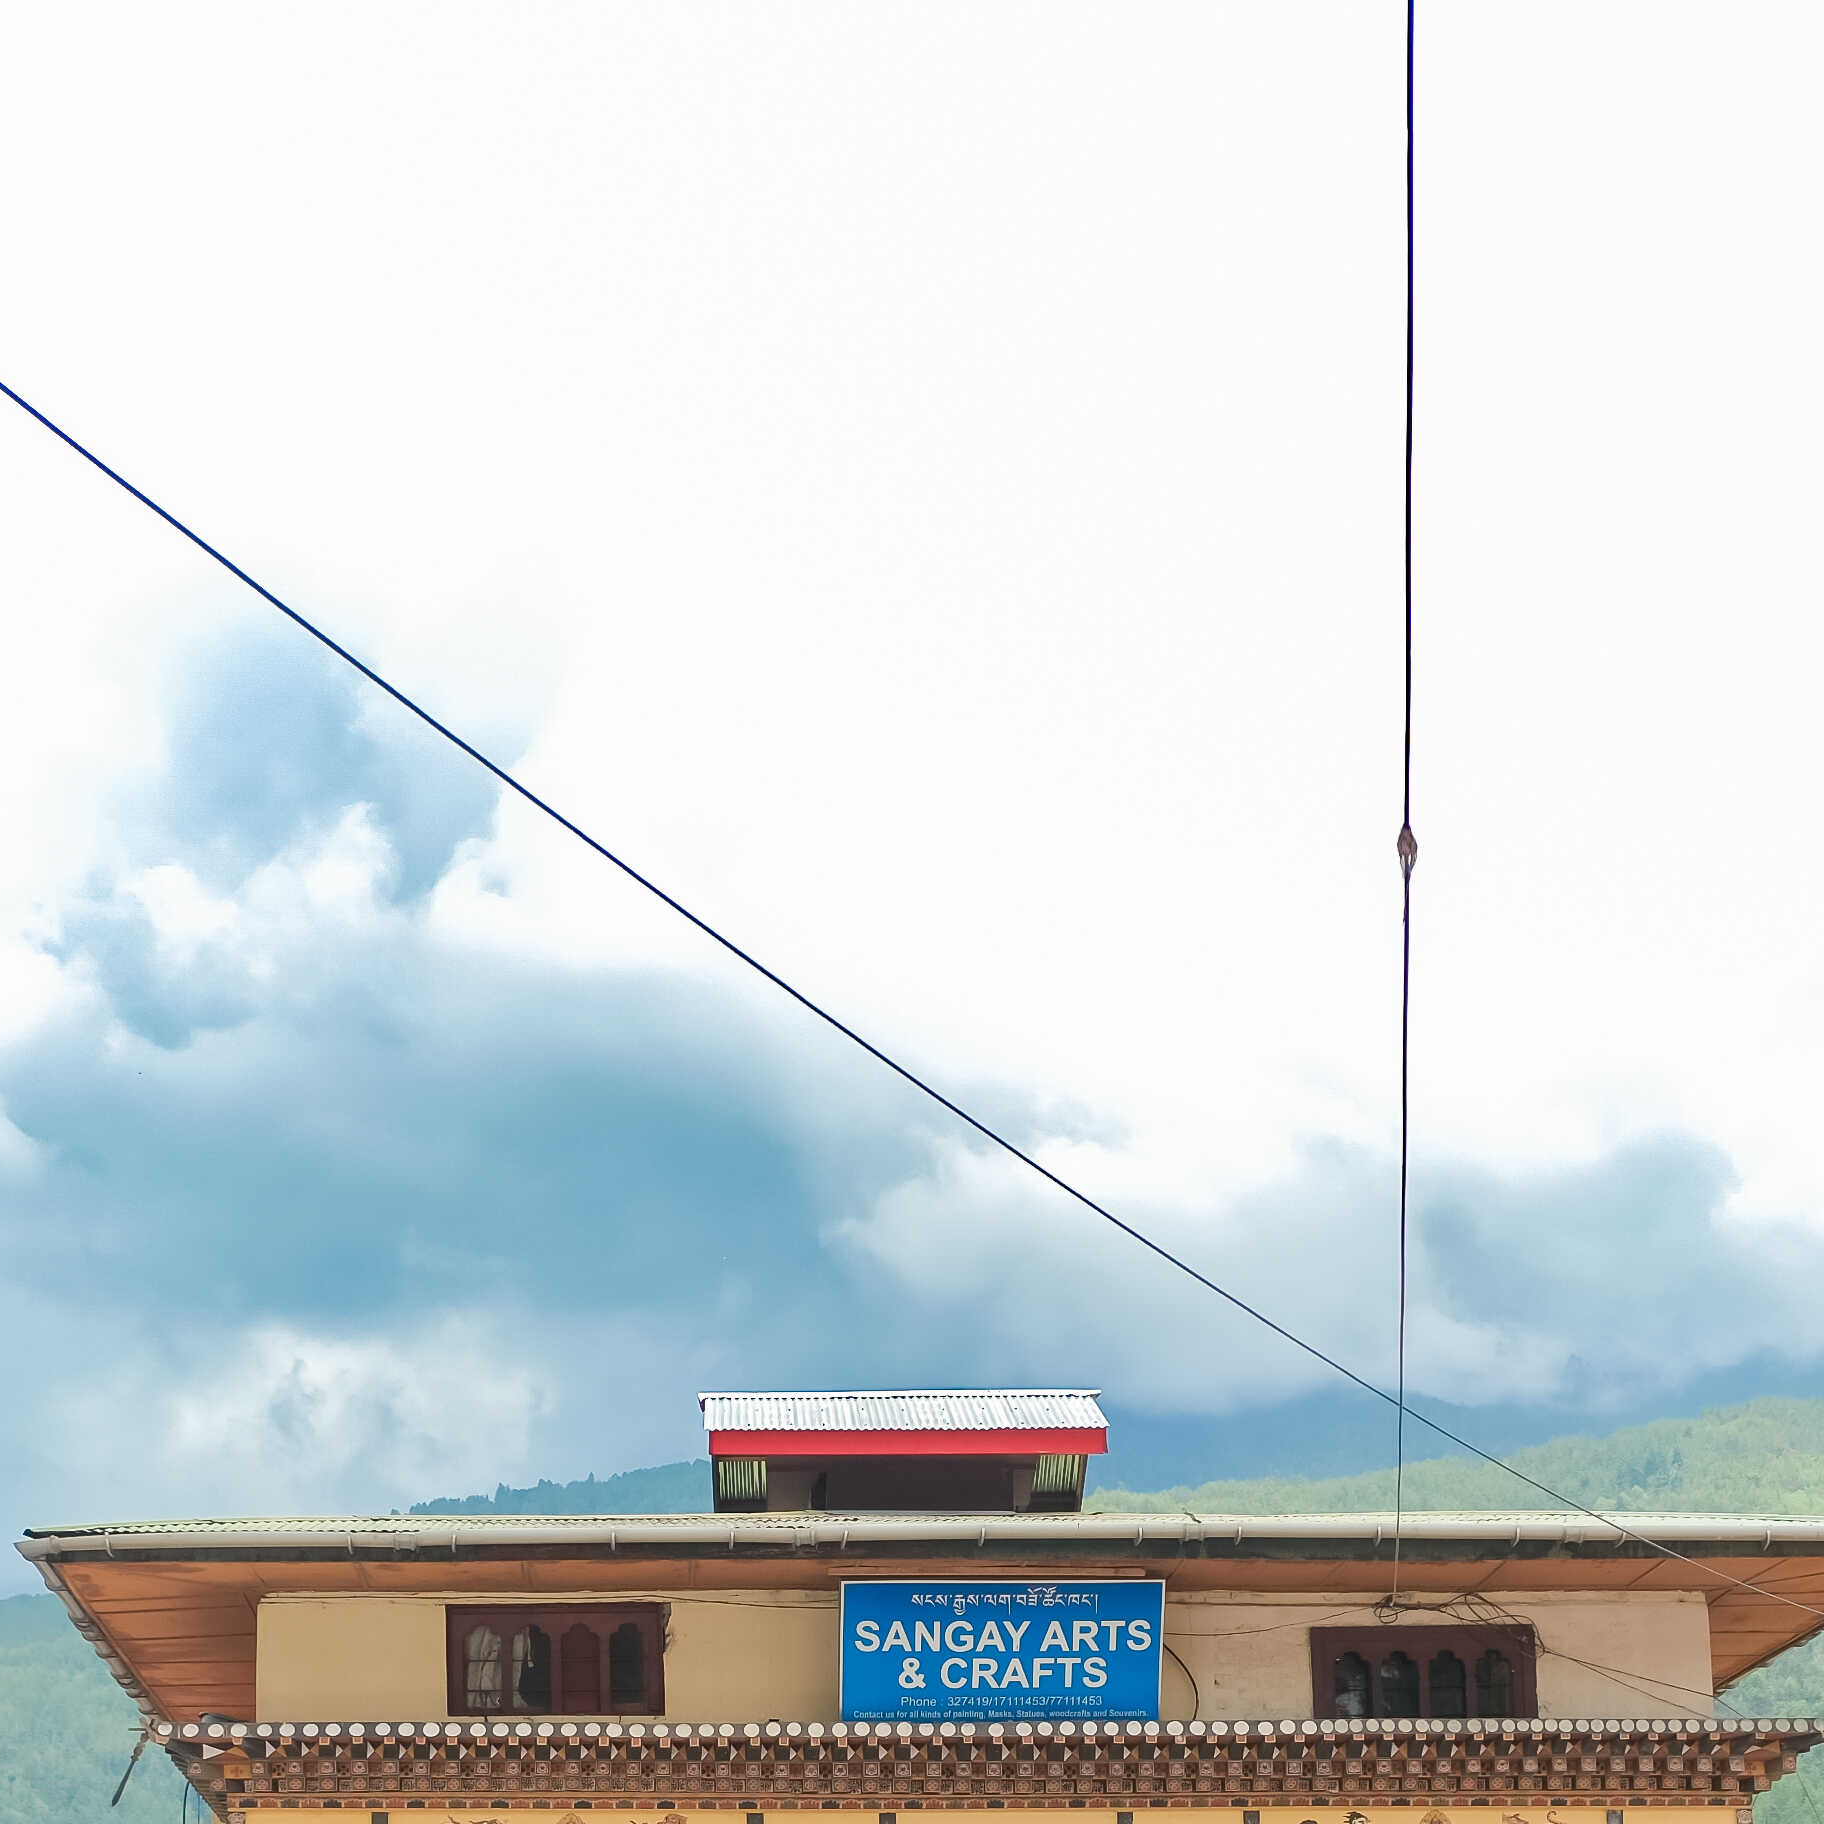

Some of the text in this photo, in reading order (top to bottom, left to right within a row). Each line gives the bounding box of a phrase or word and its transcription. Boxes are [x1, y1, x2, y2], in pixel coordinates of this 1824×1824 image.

[855, 1619, 1152, 1652] SANGAY ARTS
[898, 1657, 1108, 1688] & CRAFTS
[901, 1696, 936, 1707] Phone
[853, 1710, 883, 1719] Contact
[896, 1710, 907, 1719] for
[943, 1710, 952, 1719] of
[1093, 1709, 1107, 1717] and
